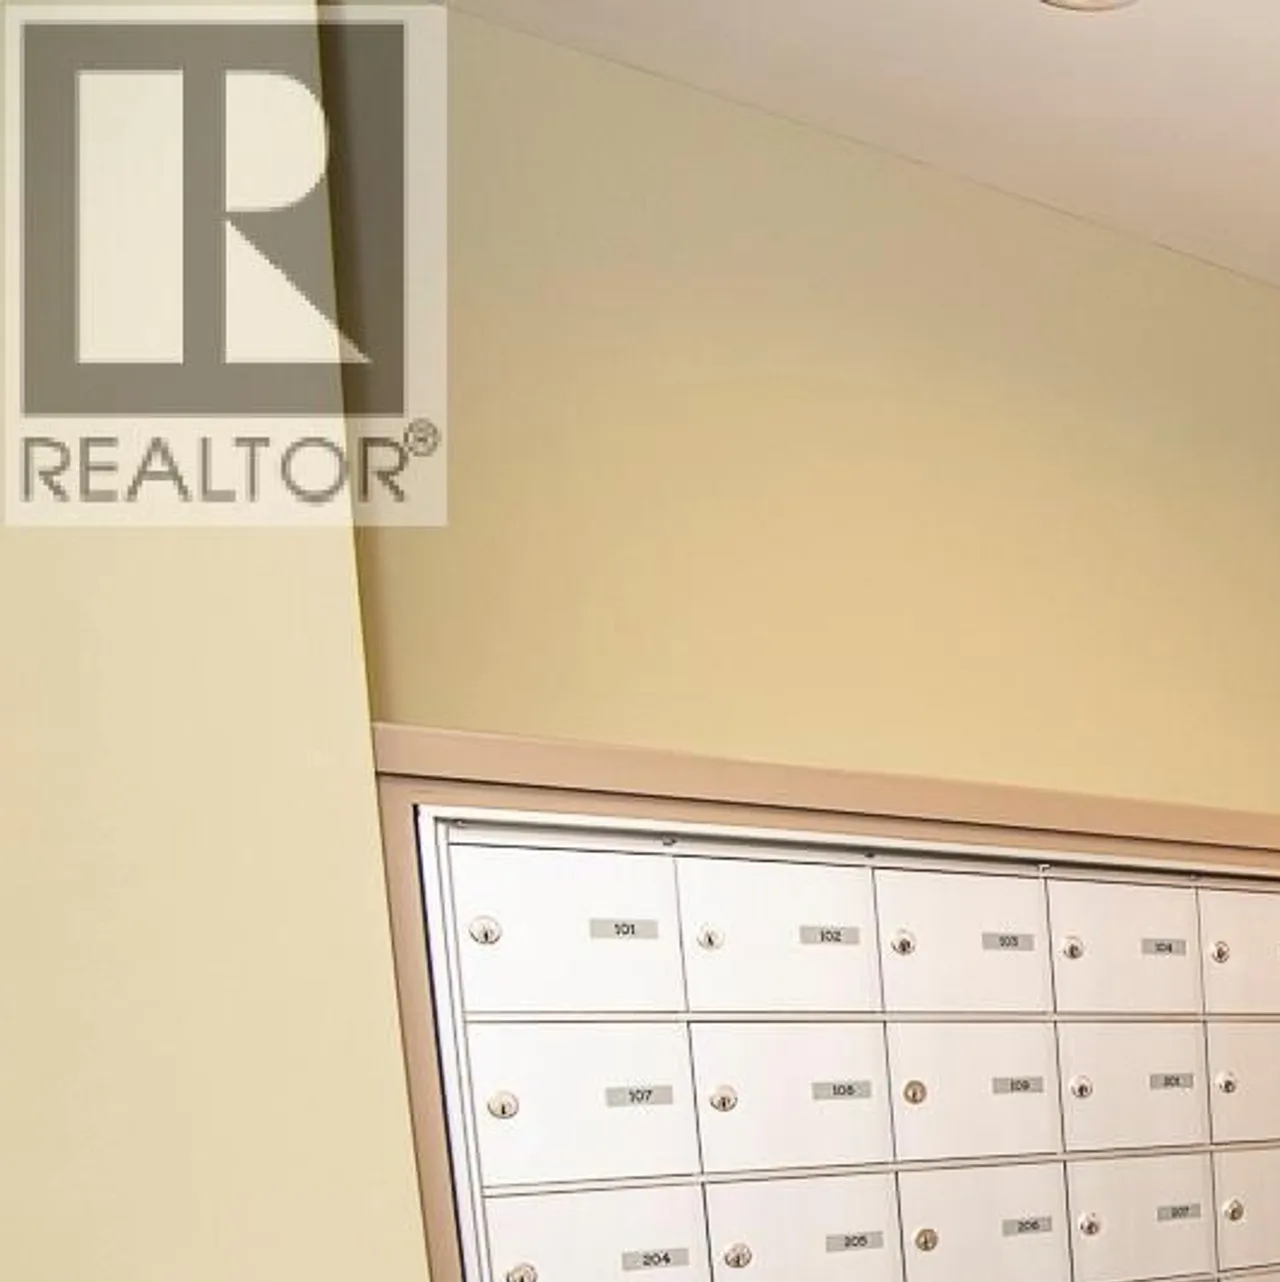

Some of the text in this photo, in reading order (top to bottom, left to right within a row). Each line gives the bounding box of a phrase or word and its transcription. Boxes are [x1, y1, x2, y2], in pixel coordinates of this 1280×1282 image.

[614, 923, 635, 935] 101
[820, 930, 842, 942] 102
[999, 936, 1018, 947] 103
[629, 1089, 652, 1103] 107
[1018, 1220, 1040, 1232] 206
[845, 1236, 867, 1248] 205
[643, 1252, 671, 1266] 204
